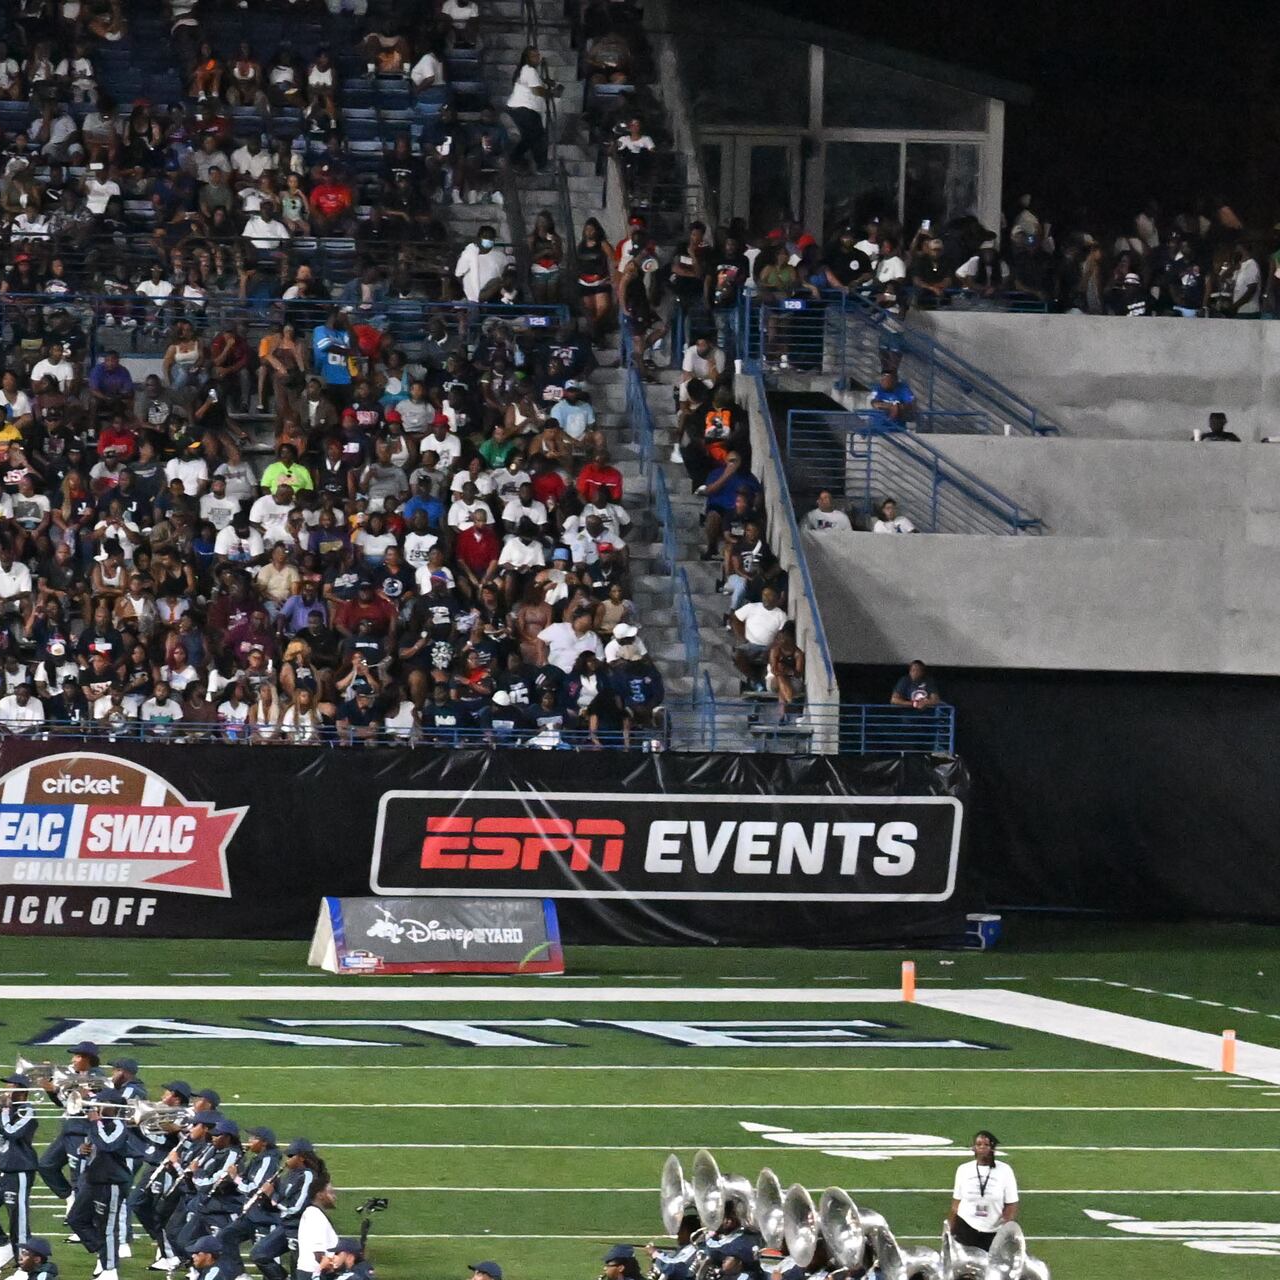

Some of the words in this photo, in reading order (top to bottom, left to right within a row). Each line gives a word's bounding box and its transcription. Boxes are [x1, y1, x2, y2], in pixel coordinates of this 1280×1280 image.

[41, 774, 124, 796] cricket
[86, 813, 198, 855] SWAC
[419, 816, 627, 872] ESPN
[643, 819, 919, 878] EVENTS
[12, 860, 132, 883] CHALLENGE
[485, 928, 524, 944] YARD
